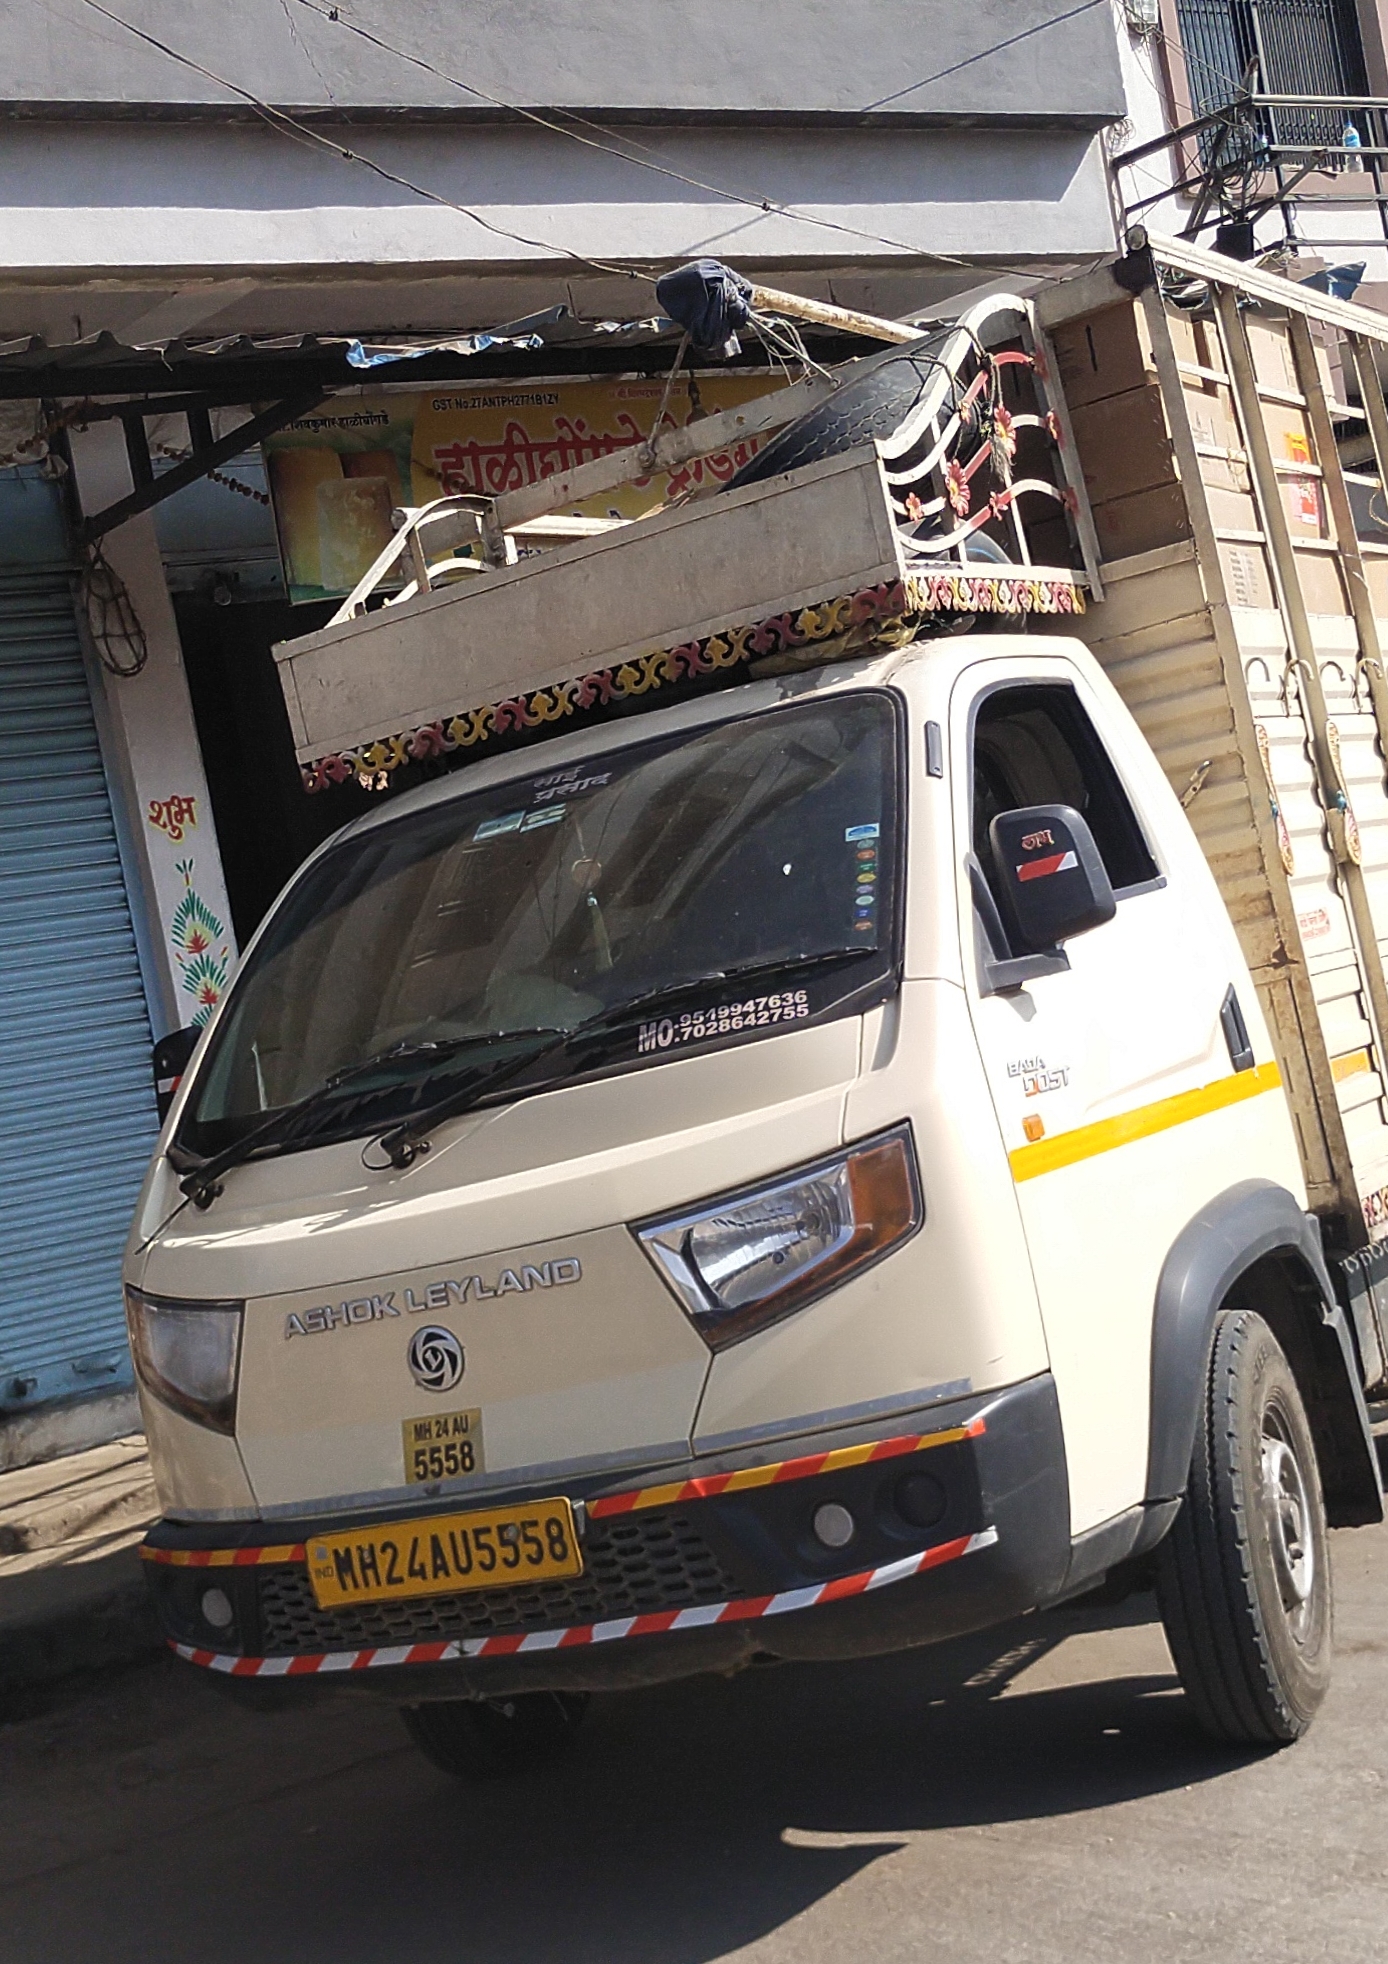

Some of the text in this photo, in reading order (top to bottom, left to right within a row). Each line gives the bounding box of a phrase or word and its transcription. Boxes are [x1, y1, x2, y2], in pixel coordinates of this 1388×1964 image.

[432, 398, 453, 411] GST
[680, 1003, 809, 1042] 7028642755
[284, 1257, 583, 1340] ASHOK LEYLAND
[413, 1415, 470, 1442] MH 24 AU
[413, 1441, 476, 1482] 5558
[332, 1516, 570, 1592] MH24AU5558
